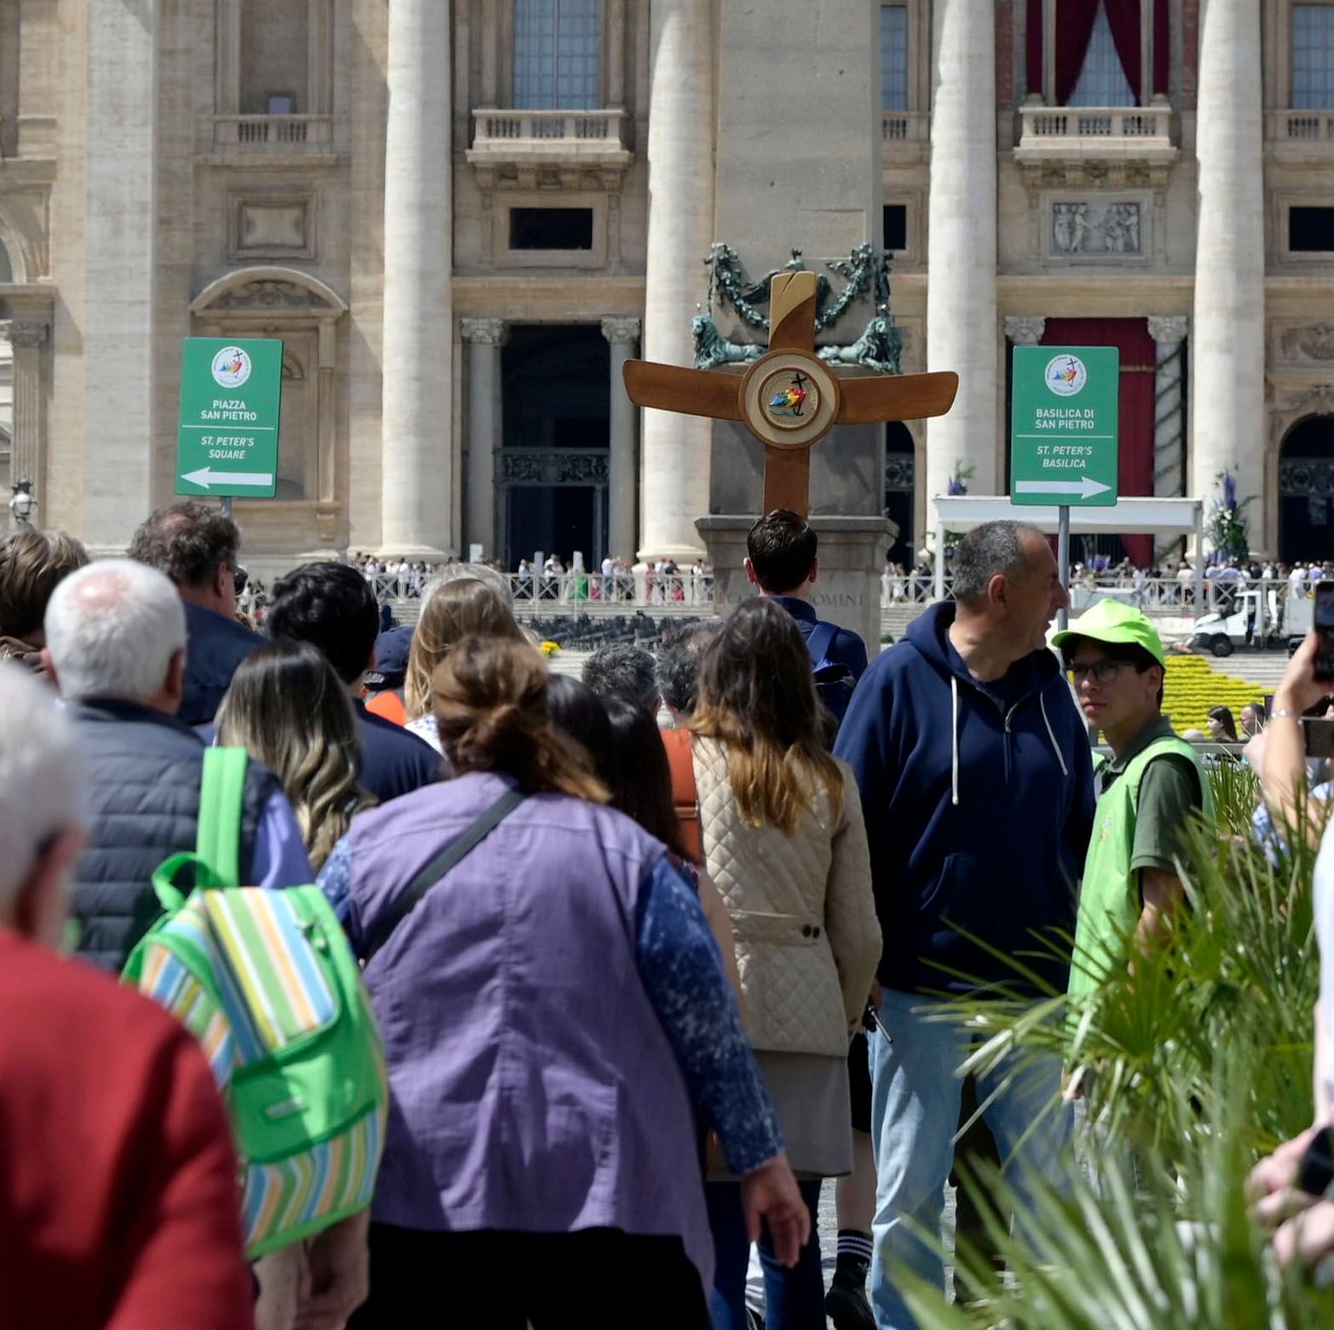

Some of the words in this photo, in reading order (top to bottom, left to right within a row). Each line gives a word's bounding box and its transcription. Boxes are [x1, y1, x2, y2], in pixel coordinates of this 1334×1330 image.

[213, 399, 246, 410] PIAZZA
[200, 410, 221, 420] SAN
[222, 411, 257, 421] PIETRO
[1036, 408, 1082, 418] BASILICA
[1084, 409, 1094, 418] DI
[1035, 419, 1056, 429] SAN
[1058, 420, 1095, 429] PIETRO
[201, 436, 215, 446] ST.
[216, 436, 255, 447] PETER'S
[208, 449, 246, 459] SQUARE
[1037, 445, 1050, 455] ST.
[1052, 445, 1093, 455] PETER'S
[1042, 458, 1086, 468] BASILICA
[807, 591, 864, 608] OMINI
